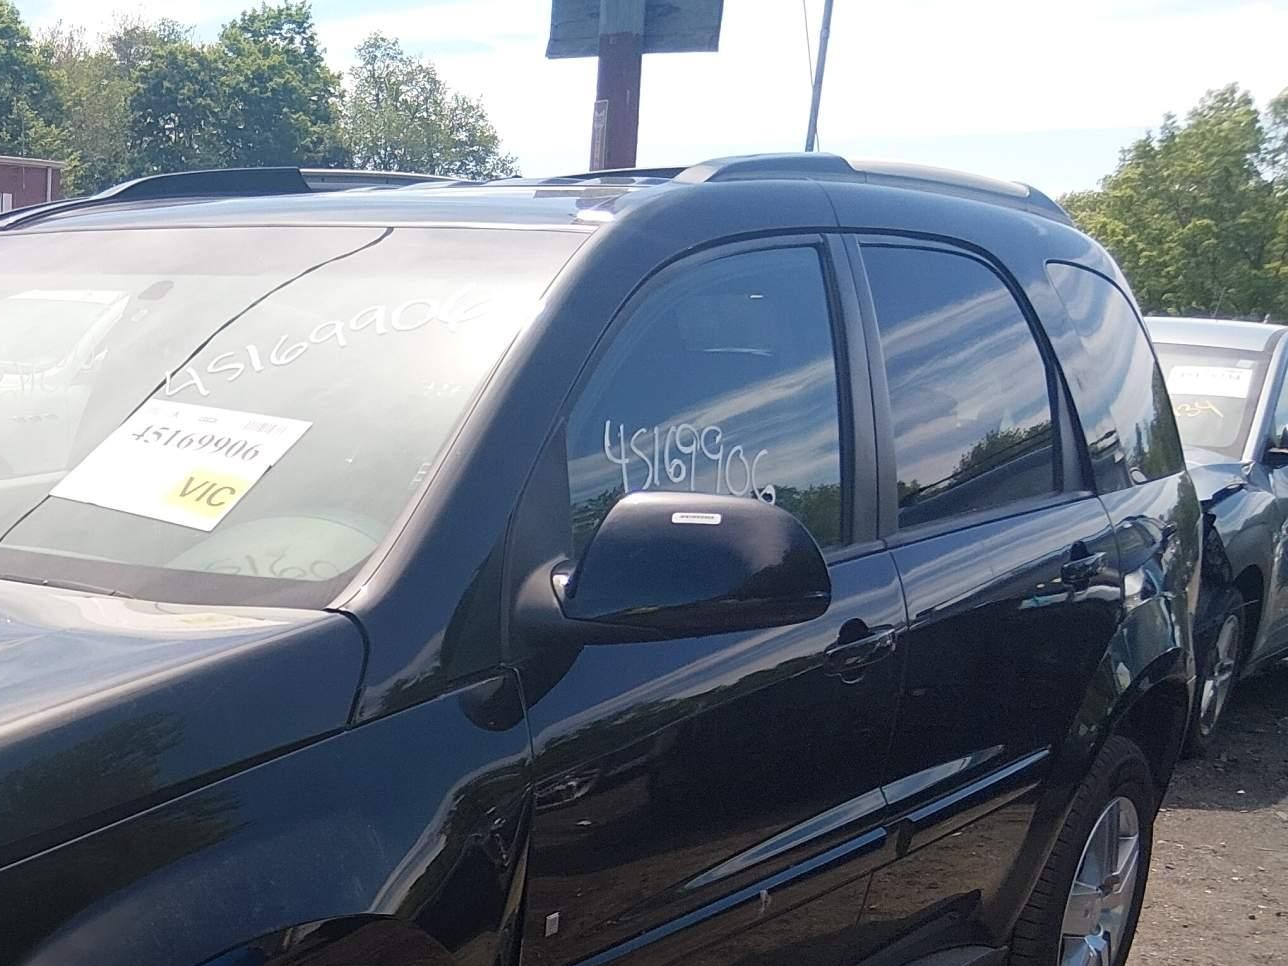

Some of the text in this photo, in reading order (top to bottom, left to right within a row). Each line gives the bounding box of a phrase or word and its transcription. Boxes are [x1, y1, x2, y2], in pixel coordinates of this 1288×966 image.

[131, 424, 263, 461] 45169906
[603, 419, 777, 505] 45169906
[178, 476, 237, 507] VIC
